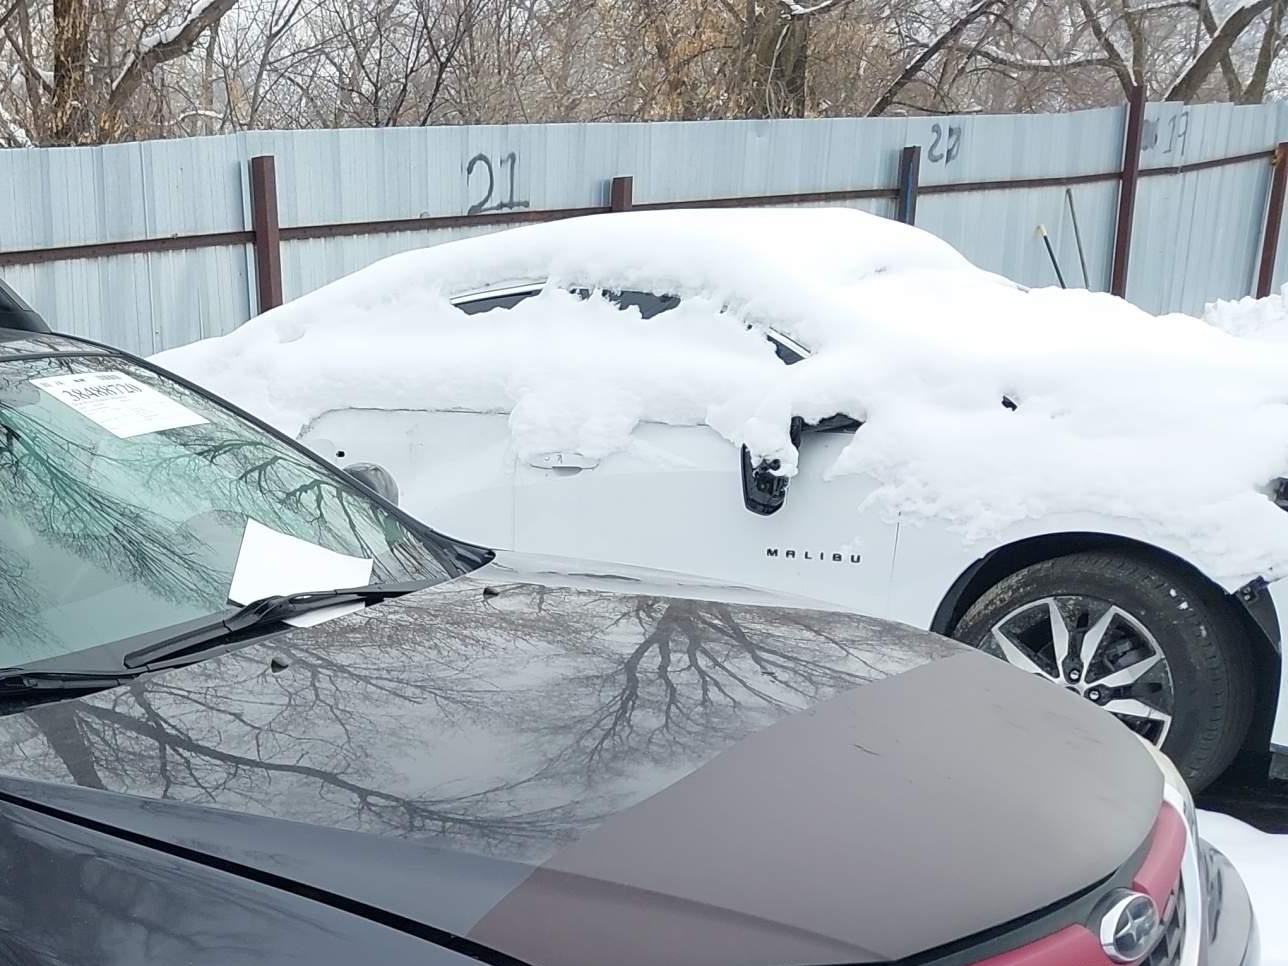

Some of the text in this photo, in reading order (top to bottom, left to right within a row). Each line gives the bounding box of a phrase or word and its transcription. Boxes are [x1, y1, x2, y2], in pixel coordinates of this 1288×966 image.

[466, 151, 530, 216] 21
[62, 382, 143, 402] 38488720
[766, 548, 861, 564] MALIBU
